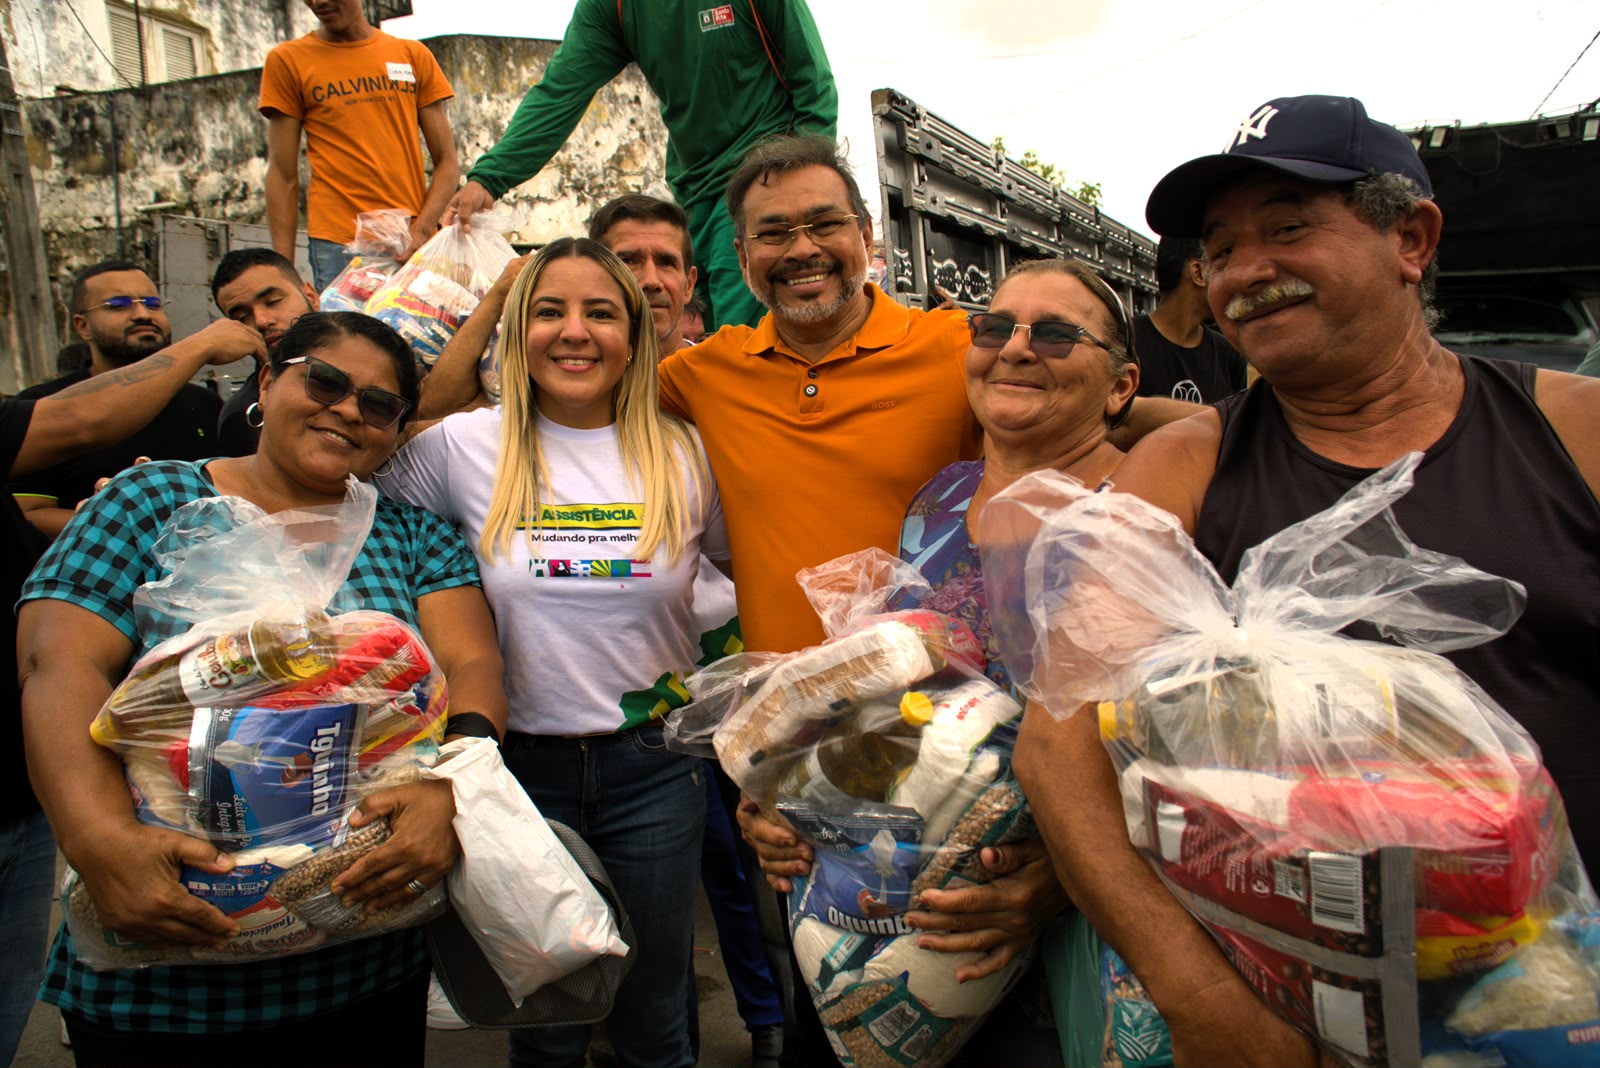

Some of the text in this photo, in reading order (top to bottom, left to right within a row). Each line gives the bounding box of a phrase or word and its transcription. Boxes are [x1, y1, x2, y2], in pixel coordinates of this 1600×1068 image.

[871, 400, 897, 409] BOSS
[541, 507, 638, 522] ASSISTÊNCIA
[531, 533, 586, 543] Mudando
[588, 535, 608, 545] pra
[240, 915, 296, 938] Tradicio
